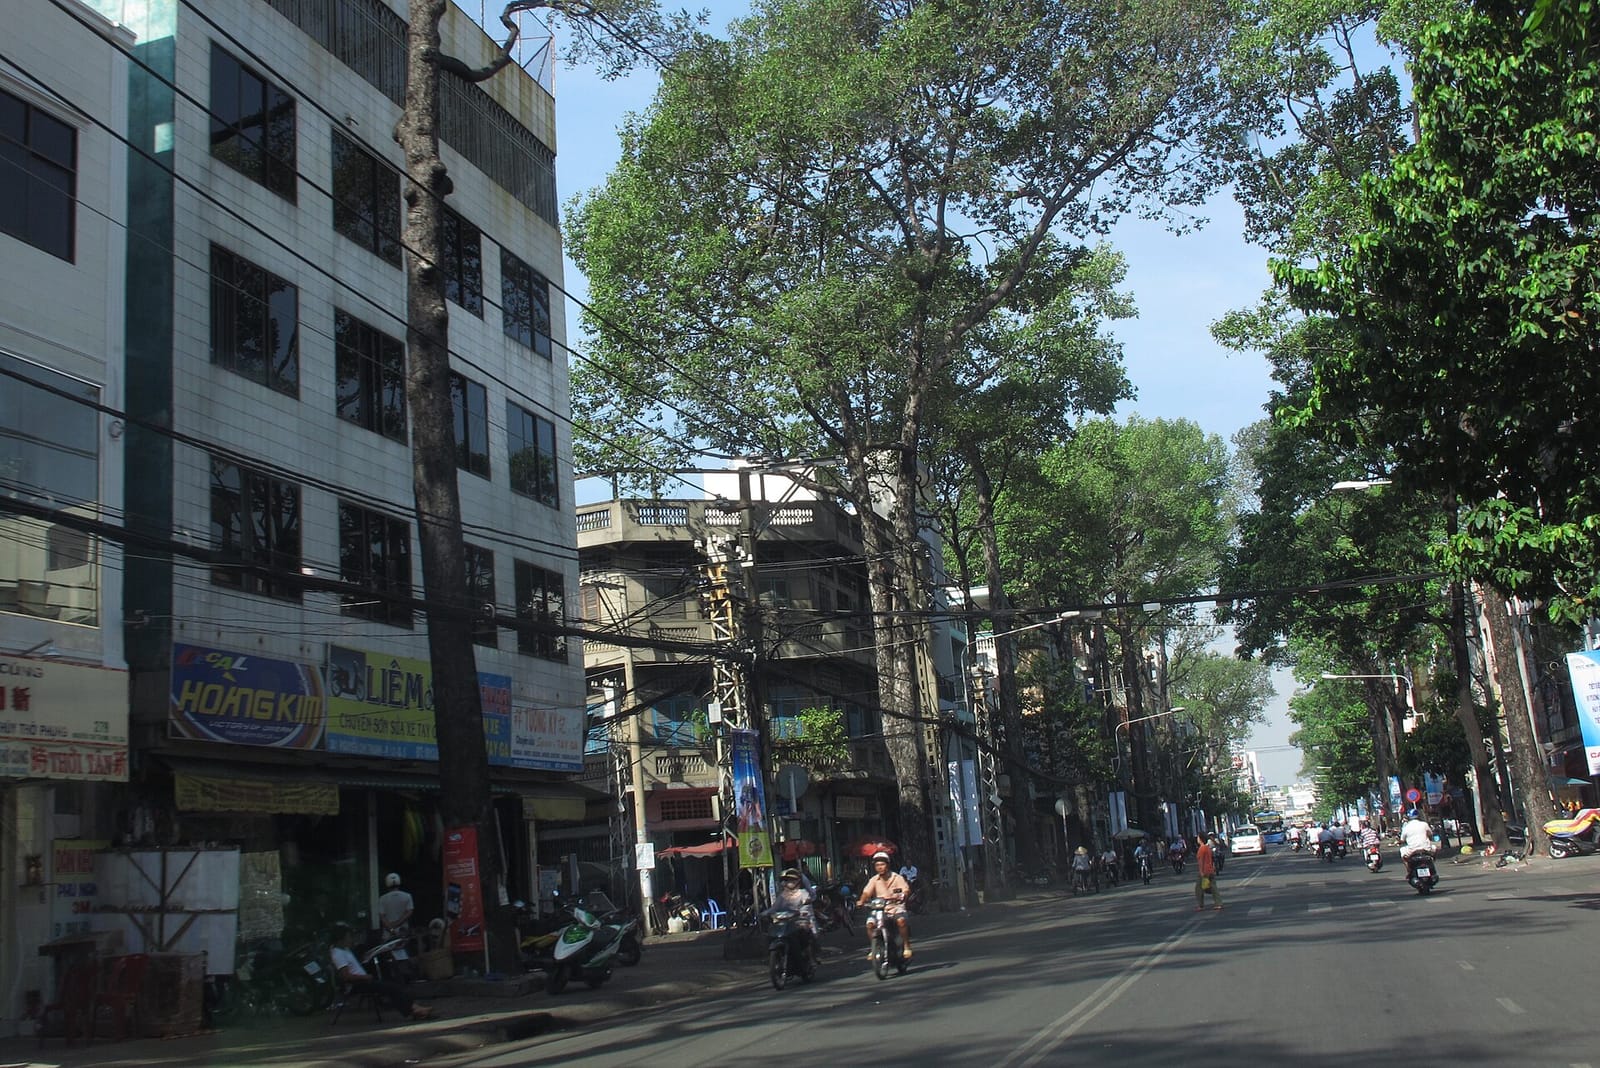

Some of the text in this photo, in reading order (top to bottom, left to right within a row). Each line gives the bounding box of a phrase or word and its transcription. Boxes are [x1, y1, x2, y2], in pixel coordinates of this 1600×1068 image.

[177, 671, 321, 726] HOÀNG KIM
[366, 659, 424, 711] LIÊM
